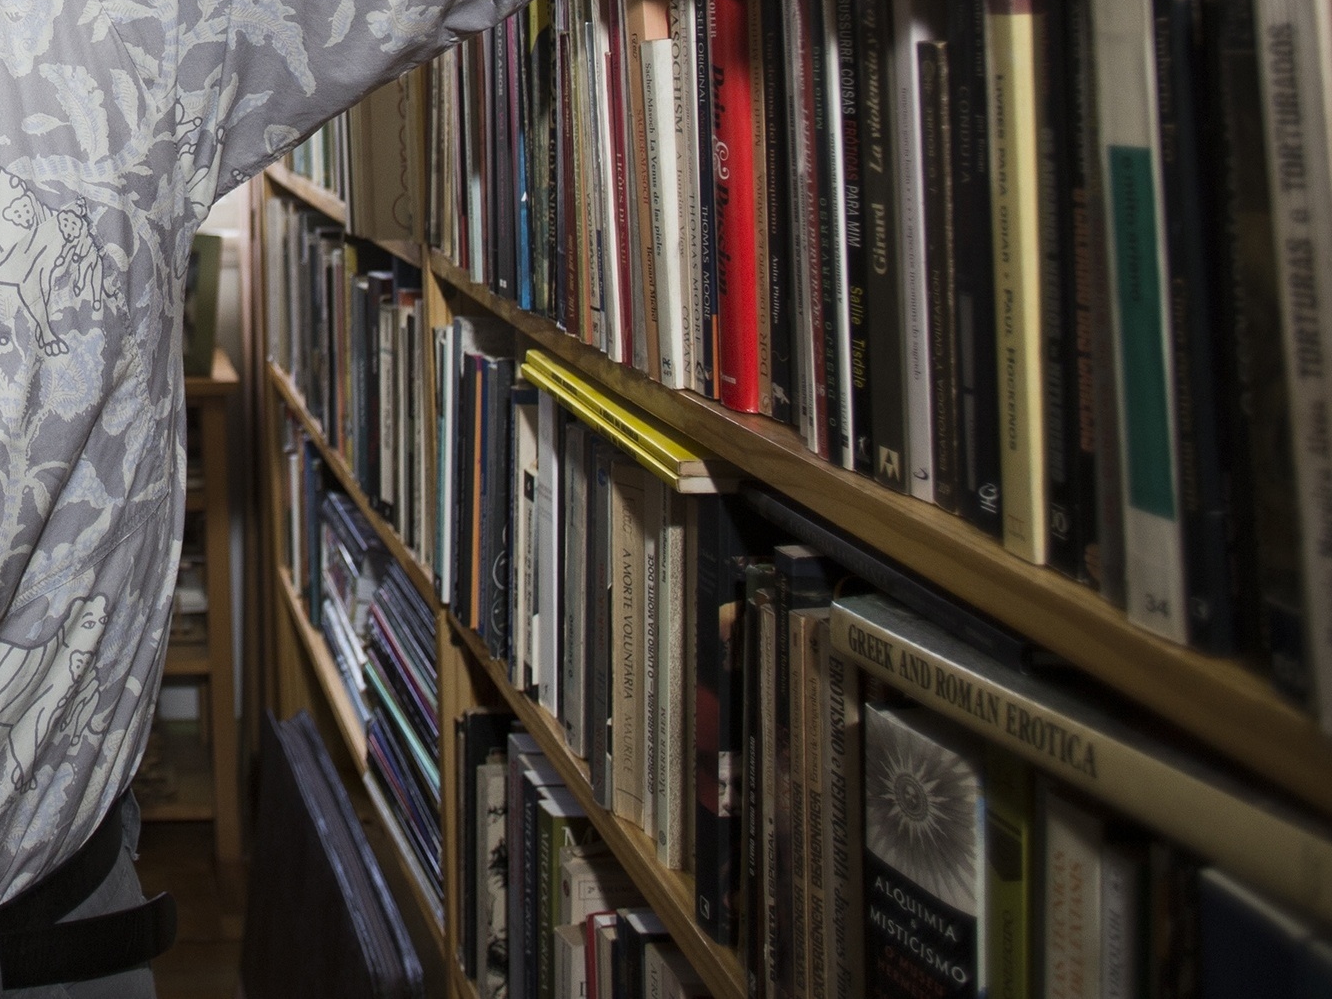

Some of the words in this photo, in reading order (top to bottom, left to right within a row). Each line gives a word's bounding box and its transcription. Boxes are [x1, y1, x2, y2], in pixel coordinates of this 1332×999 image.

[862, 9, 877, 28] lo
[863, 32, 878, 46] y
[812, 45, 822, 81] Fleig
[643, 62, 656, 133] Sacher-Masoch
[767, 63, 775, 118] defensa
[814, 88, 824, 128] Mario
[840, 68, 855, 114] COISAS
[863, 51, 881, 138] violencia
[994, 74, 1007, 139] LIVRES
[648, 139, 657, 151] La
[768, 122, 776, 144] del
[842, 119, 858, 180] ERÓTICAS
[635, 108, 650, 205] SACHER-MASOCH
[649, 154, 659, 187] Venus
[866, 146, 882, 172] La
[997, 147, 1009, 196] PARA
[652, 191, 660, 204] de
[768, 148, 777, 234] masoquismo
[845, 184, 860, 216] PARA
[653, 207, 661, 222] las
[701, 205, 709, 263] THOMAS
[847, 219, 862, 247] MIM
[999, 205, 1011, 263] ODIAR
[654, 224, 664, 256] pieles
[819, 196, 831, 301] PERVERSO
[871, 202, 886, 274] Girard
[645, 245, 656, 285] Bernard
[770, 254, 779, 281] Anita
[648, 287, 658, 322] Michel
[702, 270, 710, 320] MOORE
[771, 285, 781, 324] Phillips
[849, 285, 863, 324] Sallie
[1002, 288, 1014, 337] PAUL
[824, 321, 835, 399] DESEJO
[851, 338, 866, 388] Tisdale
[828, 417, 836, 426] O
[1004, 346, 1018, 452] HOCKENOS
[621, 548, 630, 557] A
[645, 554, 653, 581] DOCE
[621, 561, 631, 609] MORTE
[646, 585, 654, 620] MORTE
[646, 623, 654, 638] DA
[622, 615, 633, 699] VOLUNTÁRIA
[646, 640, 654, 668] LIVRO
[646, 670, 654, 679] O
[646, 691, 655, 744] BARBARIN
[658, 707, 666, 734] BEM
[847, 623, 894, 674] GREEK
[899, 650, 932, 692] AND
[935, 666, 1000, 726] ROMAN
[1006, 696, 1099, 781] EROTICA
[622, 714, 632, 775] MAURICE
[658, 739, 666, 796] MORRER
[647, 746, 655, 794] GEORGES
[749, 791, 755, 803] DO
[748, 868, 755, 876] O
[766, 829, 775, 899] ESPECIAL
[874, 875, 958, 943] ALQUIMIA
[767, 903, 777, 983] PLANETA
[870, 905, 967, 985] MISTICISMO
